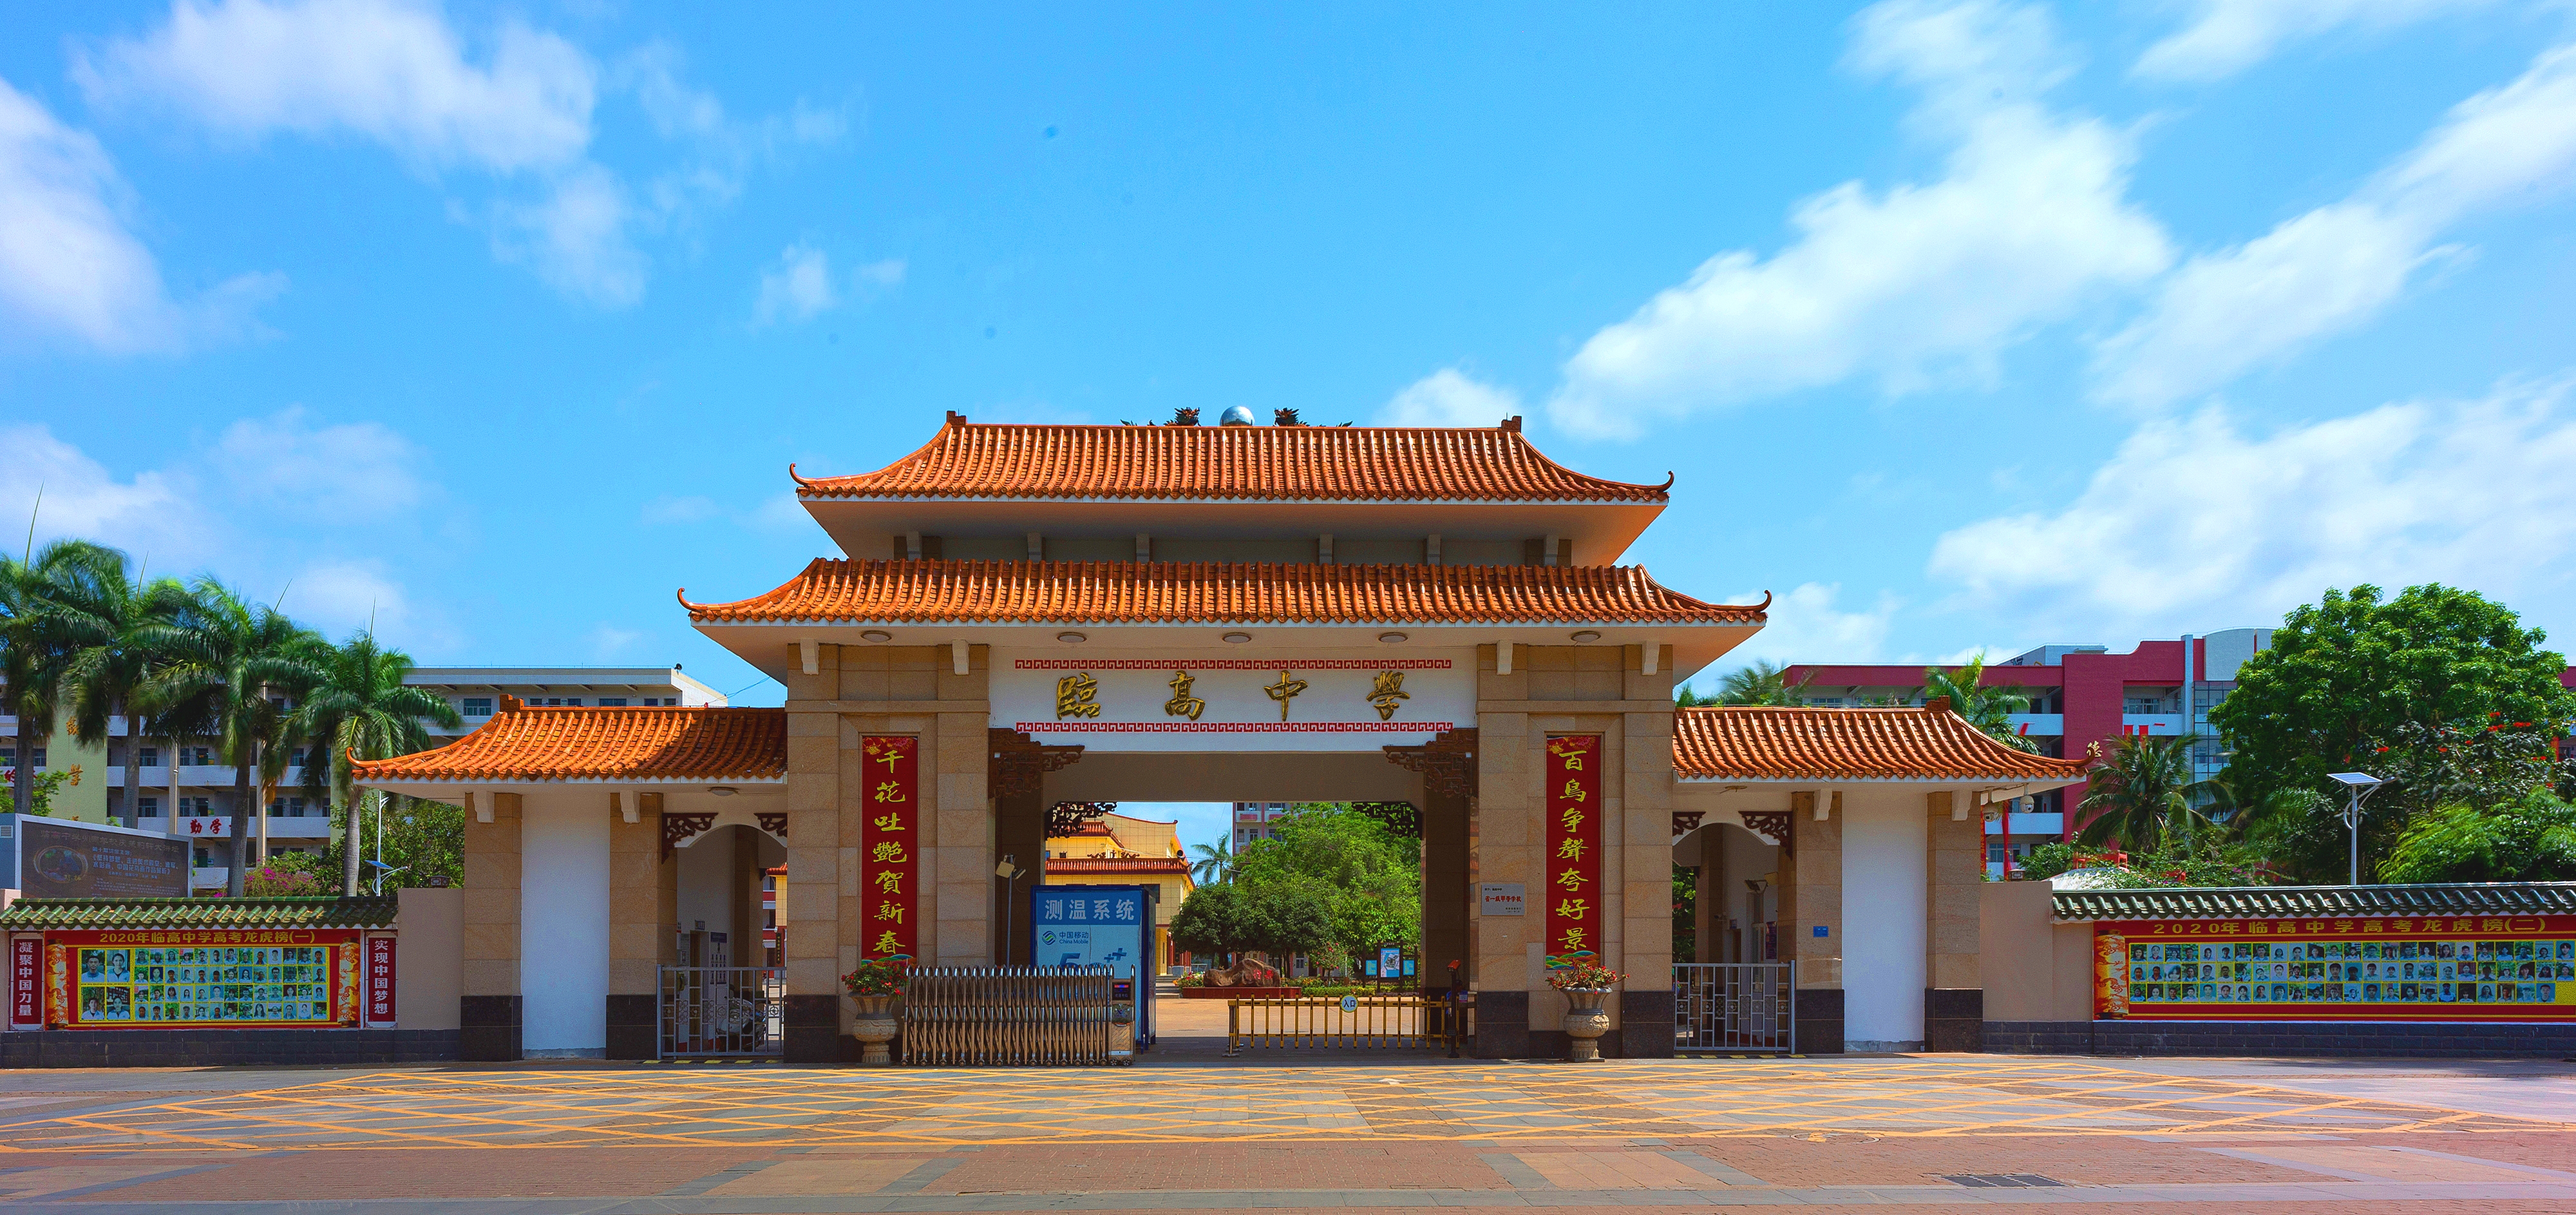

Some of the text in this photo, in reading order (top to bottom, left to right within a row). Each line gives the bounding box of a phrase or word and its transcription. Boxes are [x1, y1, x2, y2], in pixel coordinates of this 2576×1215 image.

[1057, 670, 1410, 722] 臨高中學
[1045, 899, 1134, 921] 测温系统
[100, 932, 315, 943] 2020年临高中学高考龙虎榜(一)
[1059, 931, 1089, 939] 中国移动
[19, 942, 33, 1016] 凝聚中国力量
[374, 940, 388, 1014] 实现中国梦想
[1343, 999, 1356, 1008] 入口
